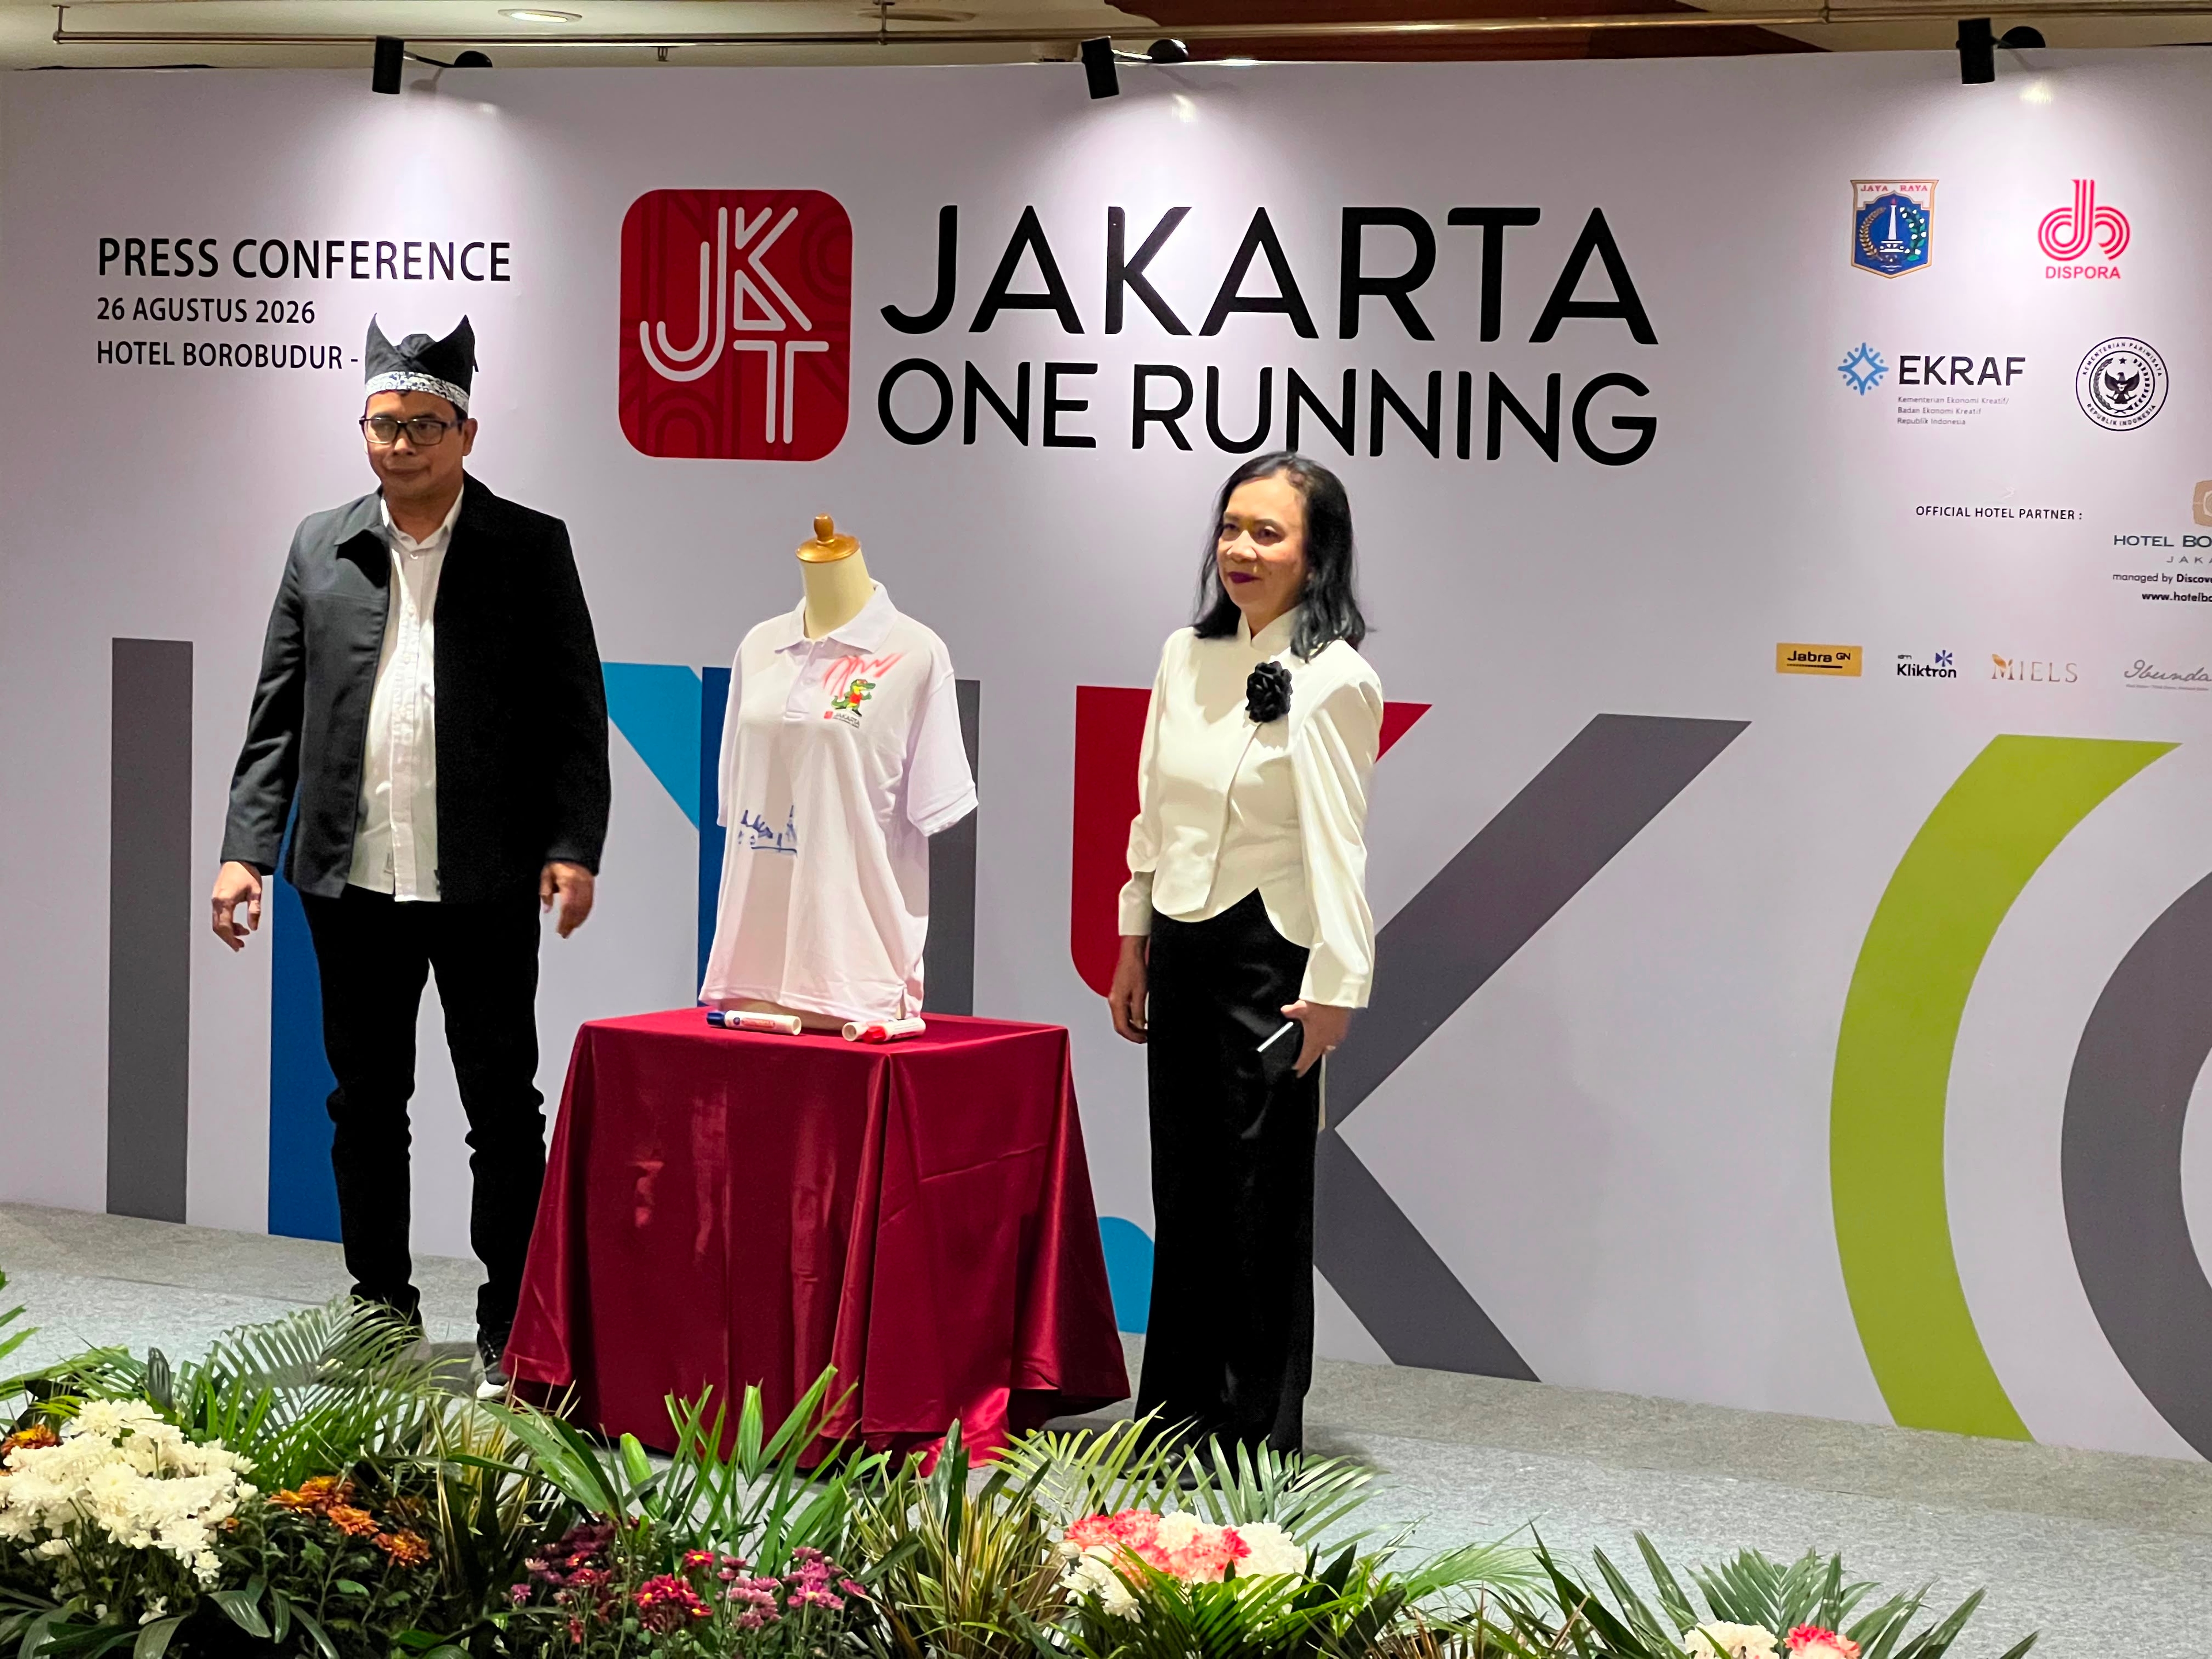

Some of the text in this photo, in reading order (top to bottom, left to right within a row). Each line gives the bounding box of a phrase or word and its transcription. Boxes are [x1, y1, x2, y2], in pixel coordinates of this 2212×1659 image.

[100, 238, 510, 281] PRESS CONFERENCE
[2046, 266, 2121, 279] DISPORA
[880, 205, 1658, 344] JAKARTA
[97, 297, 315, 324] 26 AGUSTUS 2026
[97, 341, 175, 366] HOTEL
[183, 343, 342, 369] BOROBUDUR
[2082, 342, 2162, 377] KEMENTERIAN PARIWISATA
[1899, 355, 2026, 385] EKRAF
[878, 358, 1657, 466] ONE RUNNING
[2087, 403, 2156, 426] REPUBLIK INDONESIA
[1916, 506, 1971, 517] OFFICIAL
[1975, 507, 2014, 518] HOTEL
[2019, 509, 2075, 520] PARTNER
[2113, 535, 2175, 547] HOTEL
[2112, 573, 2158, 584] managed
[2162, 573, 2173, 585] by
[1787, 650, 1851, 662] Jabra GN
[1991, 656, 2078, 683] MIELS
[1897, 663, 1957, 679] Kliktron
